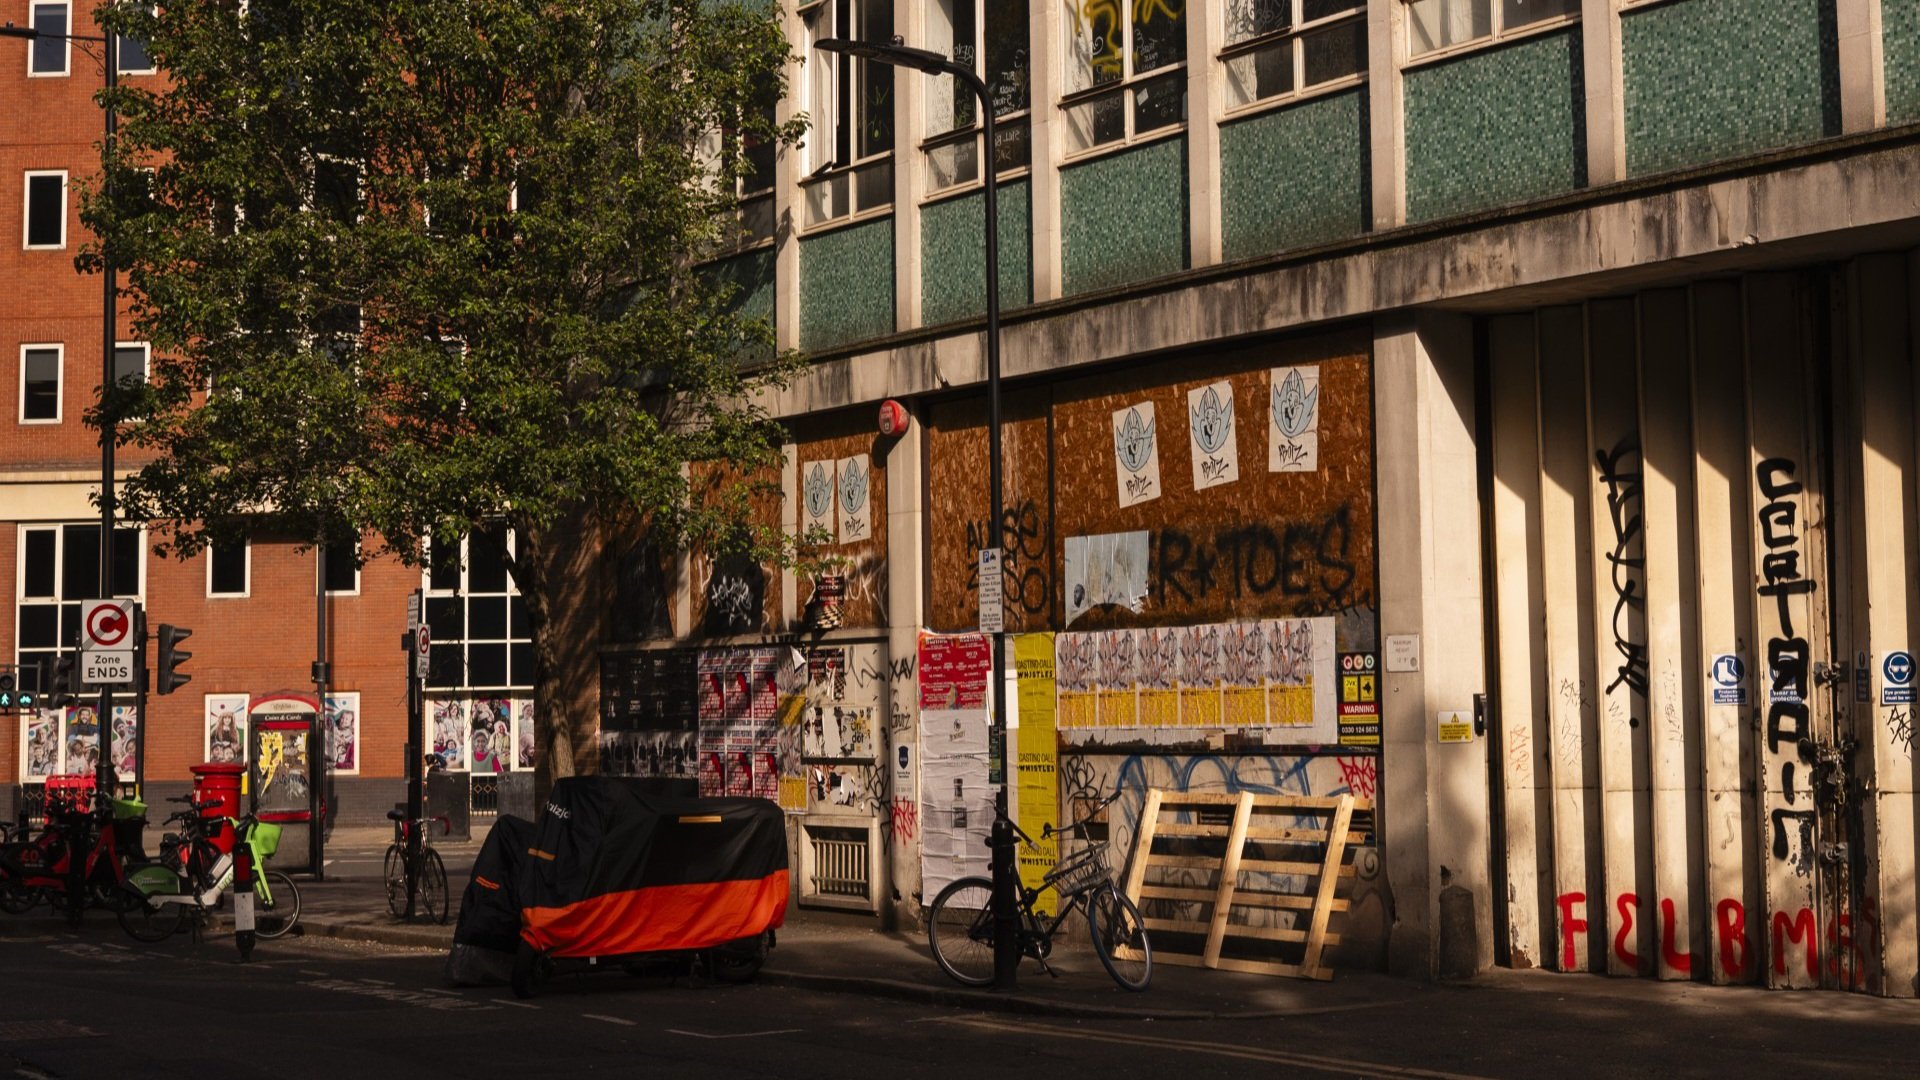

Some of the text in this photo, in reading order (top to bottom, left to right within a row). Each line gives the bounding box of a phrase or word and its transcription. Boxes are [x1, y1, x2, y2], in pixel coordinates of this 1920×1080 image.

[95, 655, 120, 664] Zone
[88, 667, 128, 678] ENDS
[1017, 670, 1053, 679] WHISTLES
[1344, 705, 1375, 713] WARNING
[1018, 753, 1054, 762] CASTING CALL
[1019, 764, 1055, 773] WHISTLES
[1043, 847, 1056, 857] CALL
[1020, 857, 1056, 866] WHISTLES
